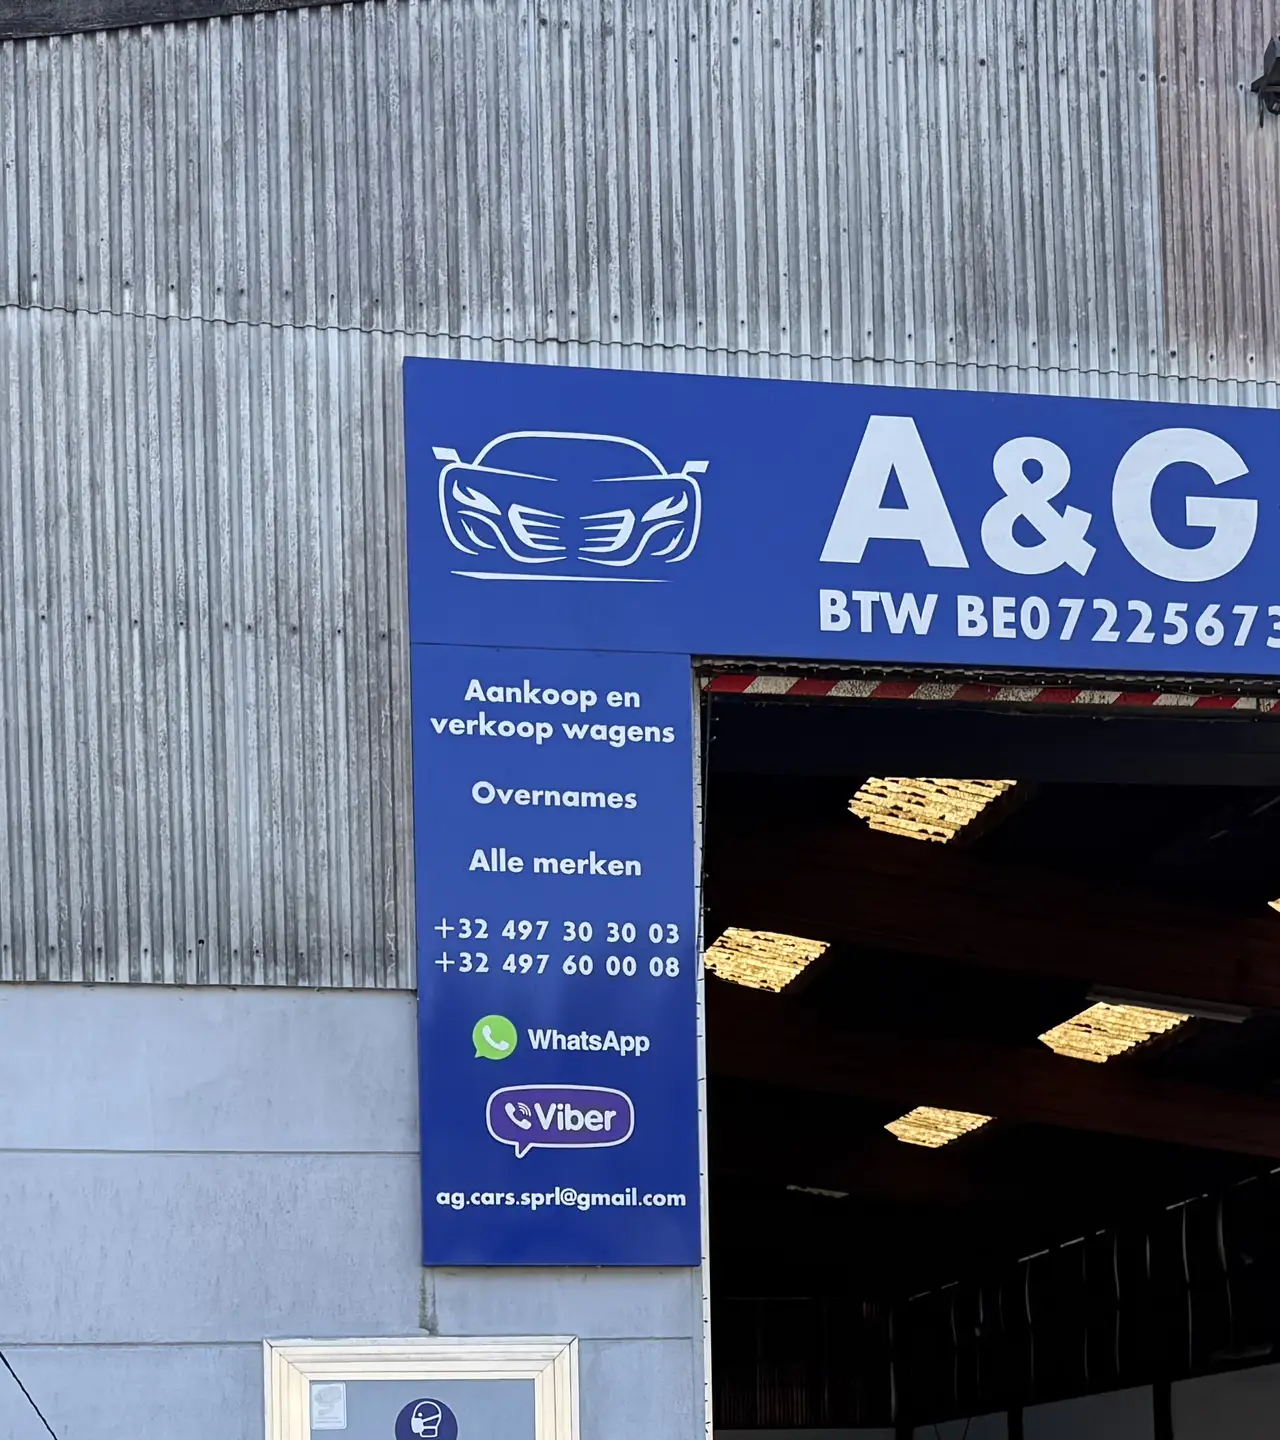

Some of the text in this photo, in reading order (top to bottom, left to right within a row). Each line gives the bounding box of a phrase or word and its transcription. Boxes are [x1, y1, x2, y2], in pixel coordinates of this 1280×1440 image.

[819, 414, 1260, 583] A&G
[819, 588, 939, 635] BTW
[464, 679, 640, 710] Aankoop en
[430, 711, 675, 748] verkoop wagens
[471, 780, 638, 809] Overnames
[468, 847, 642, 876] Alle merken
[434, 917, 680, 944] +32 497 30 30 03
[434, 951, 680, 978] +32 497 60 00 08
[527, 1028, 650, 1057] WhatsApp
[533, 1102, 617, 1132] Viber
[436, 1186, 686, 1211] ag.cars.sprl@gmail.com
